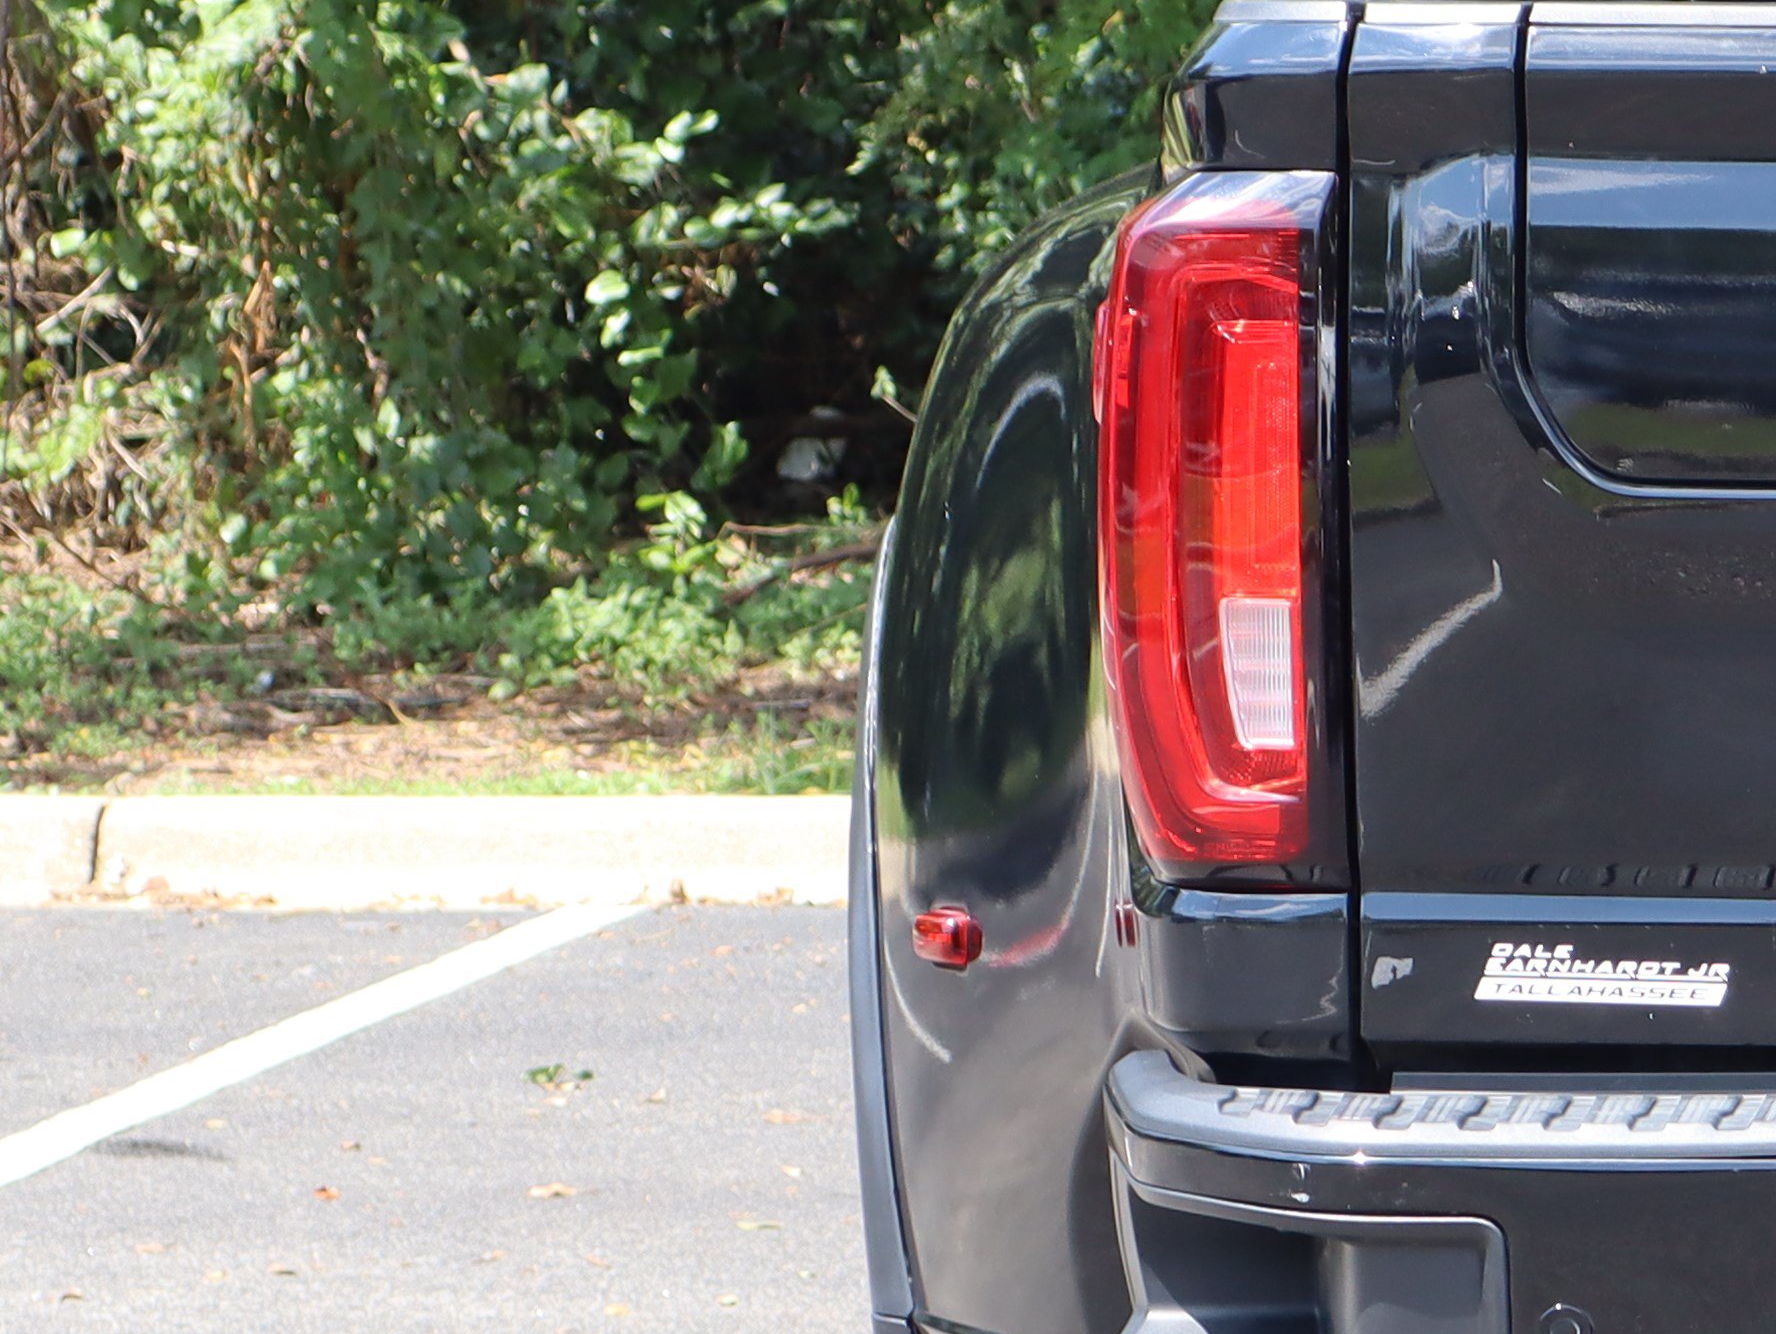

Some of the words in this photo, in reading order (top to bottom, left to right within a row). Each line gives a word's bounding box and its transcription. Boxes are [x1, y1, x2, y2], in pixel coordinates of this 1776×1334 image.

[1491, 942, 1574, 959] DALE
[1484, 957, 1681, 978] EARNHARDT
[1687, 962, 1731, 982] JR
[1493, 982, 1709, 1000] TALLAHASSEE
